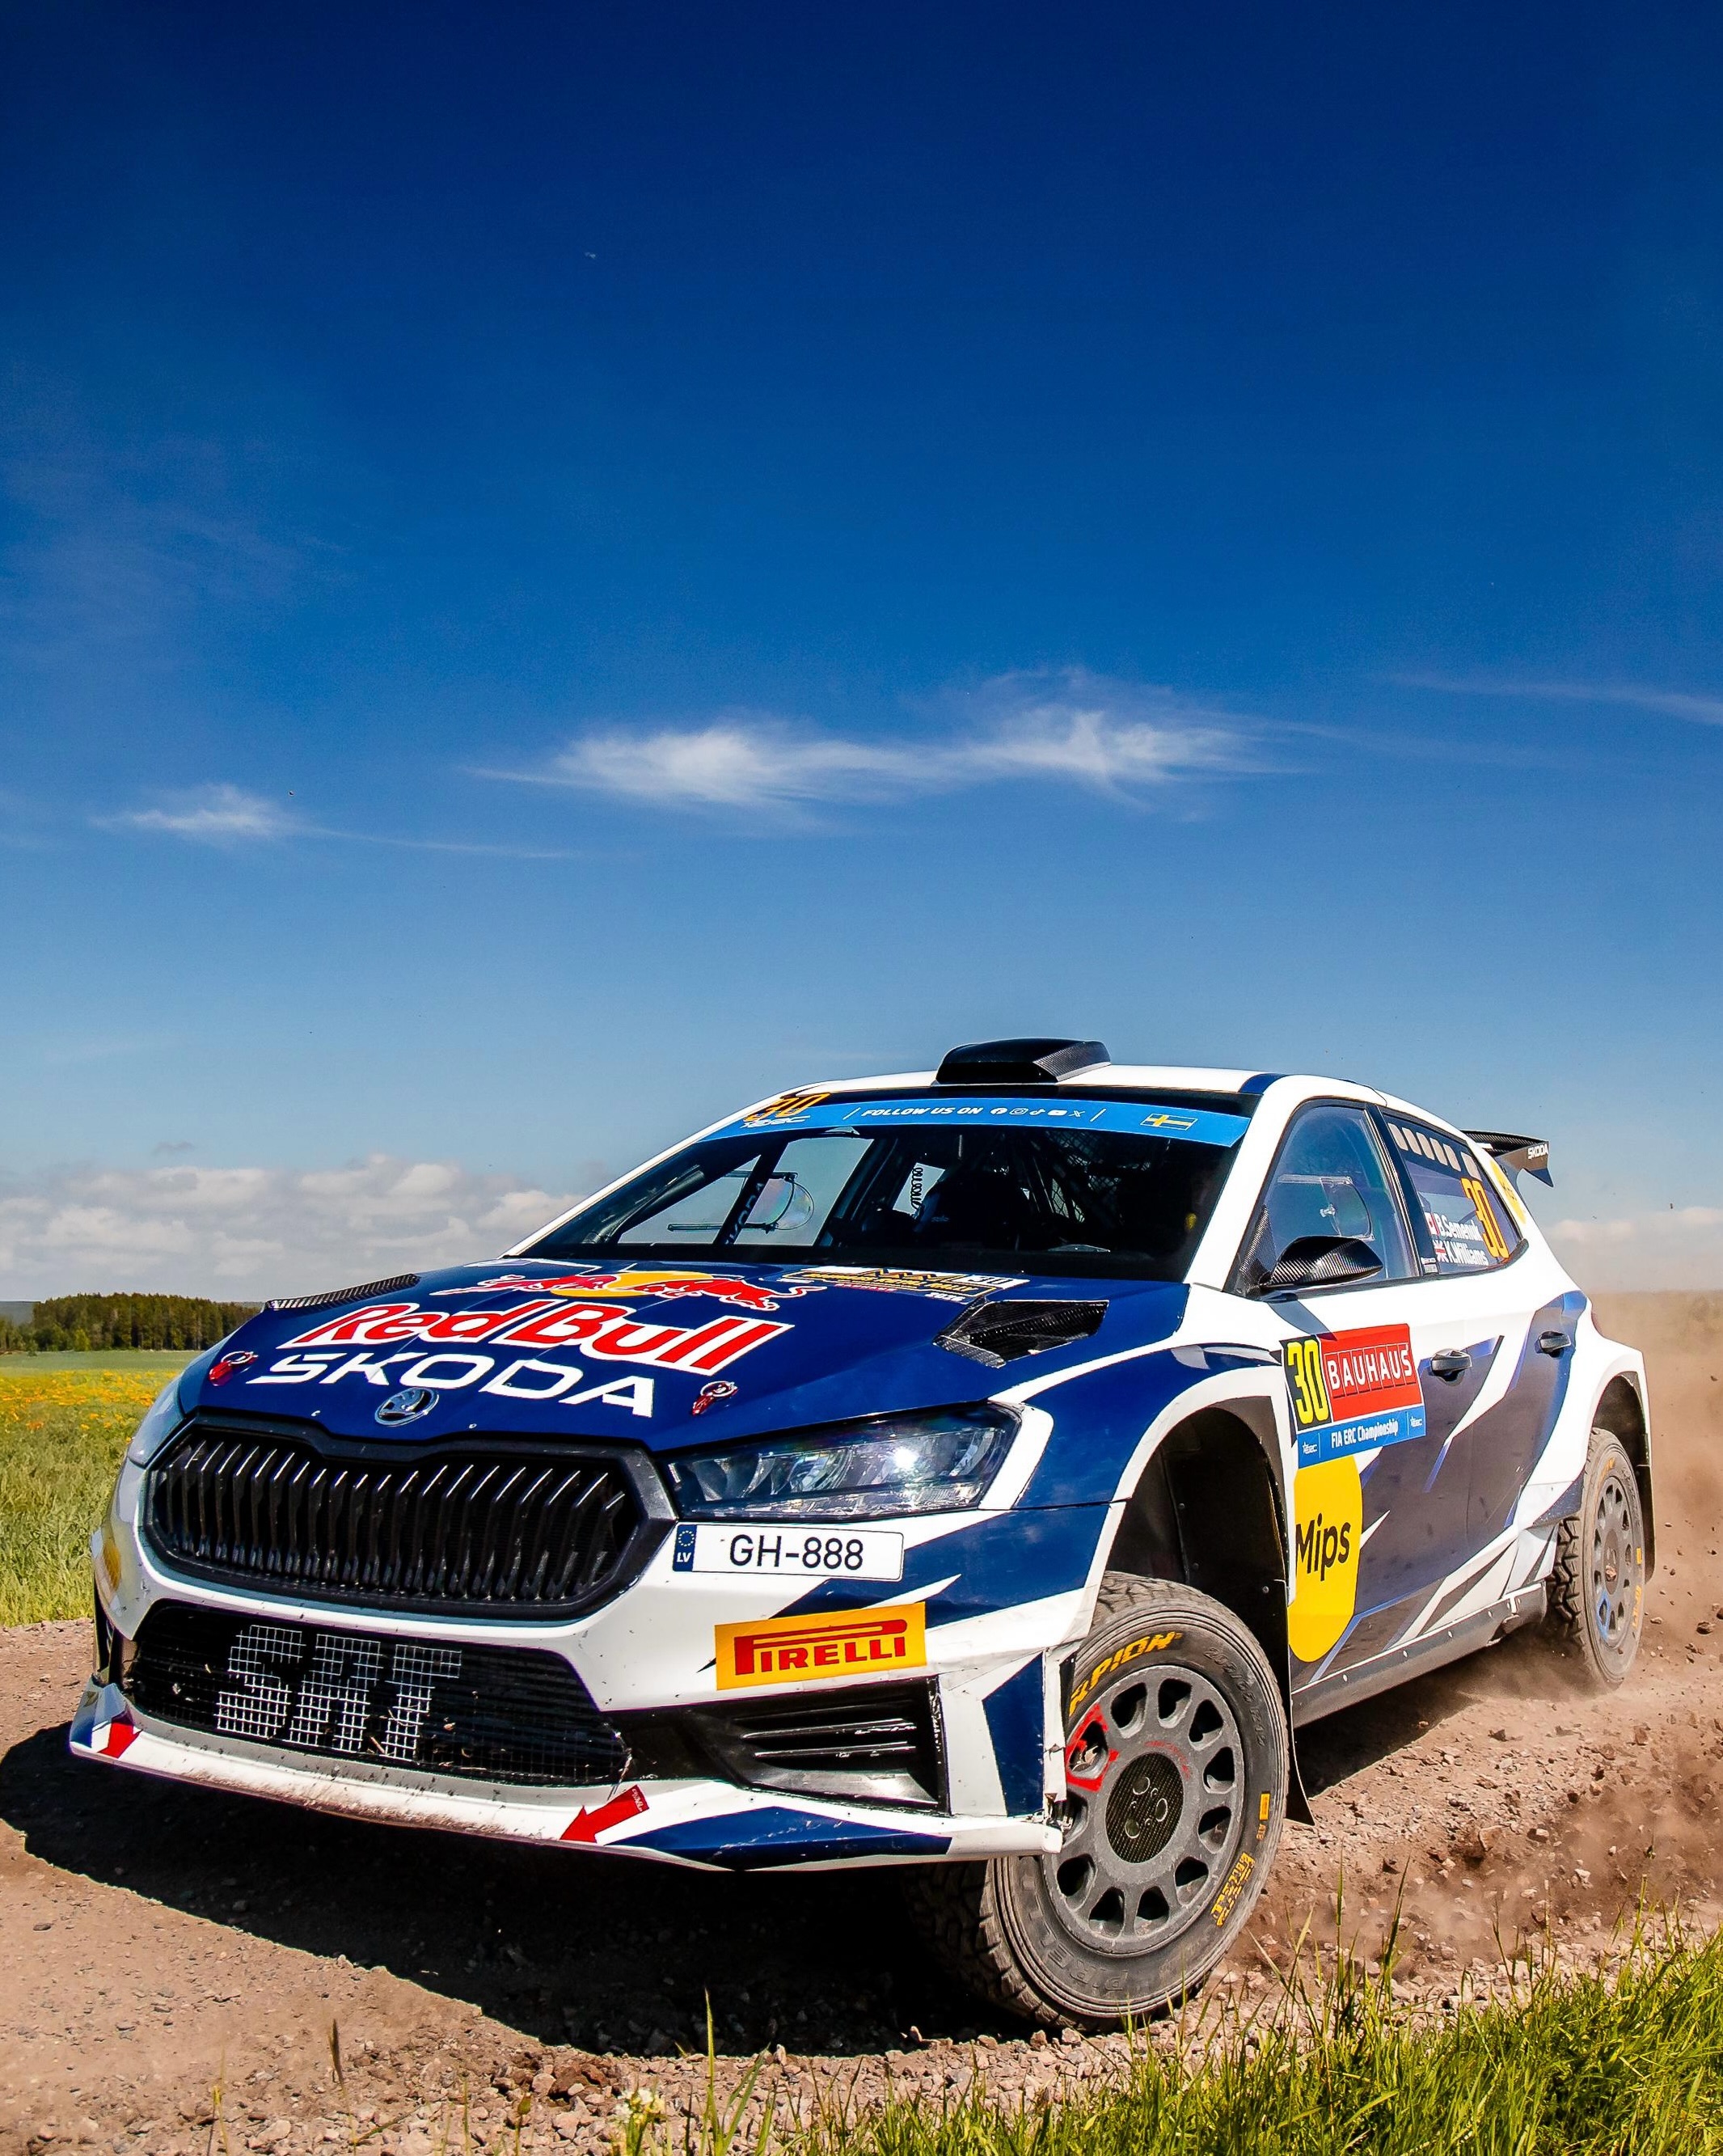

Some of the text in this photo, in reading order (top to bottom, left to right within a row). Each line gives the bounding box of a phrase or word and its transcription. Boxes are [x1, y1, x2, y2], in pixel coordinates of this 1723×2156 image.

[743, 1093, 831, 1122] 30
[861, 1107, 984, 1118] FOLLOW US ON
[1459, 1177, 1510, 1258] 30
[967, 1275, 1015, 1285] 30
[277, 1300, 795, 1375] Red Bull
[1287, 1339, 1413, 1425] 30 BAUHAUS
[1331, 1418, 1400, 1448] FIA ERC Championship
[676, 1551, 692, 1563] LV
[729, 1534, 864, 1570] GH-888
[1295, 1512, 1352, 1582] Mips
[733, 1618, 909, 1676] PIRELLI
